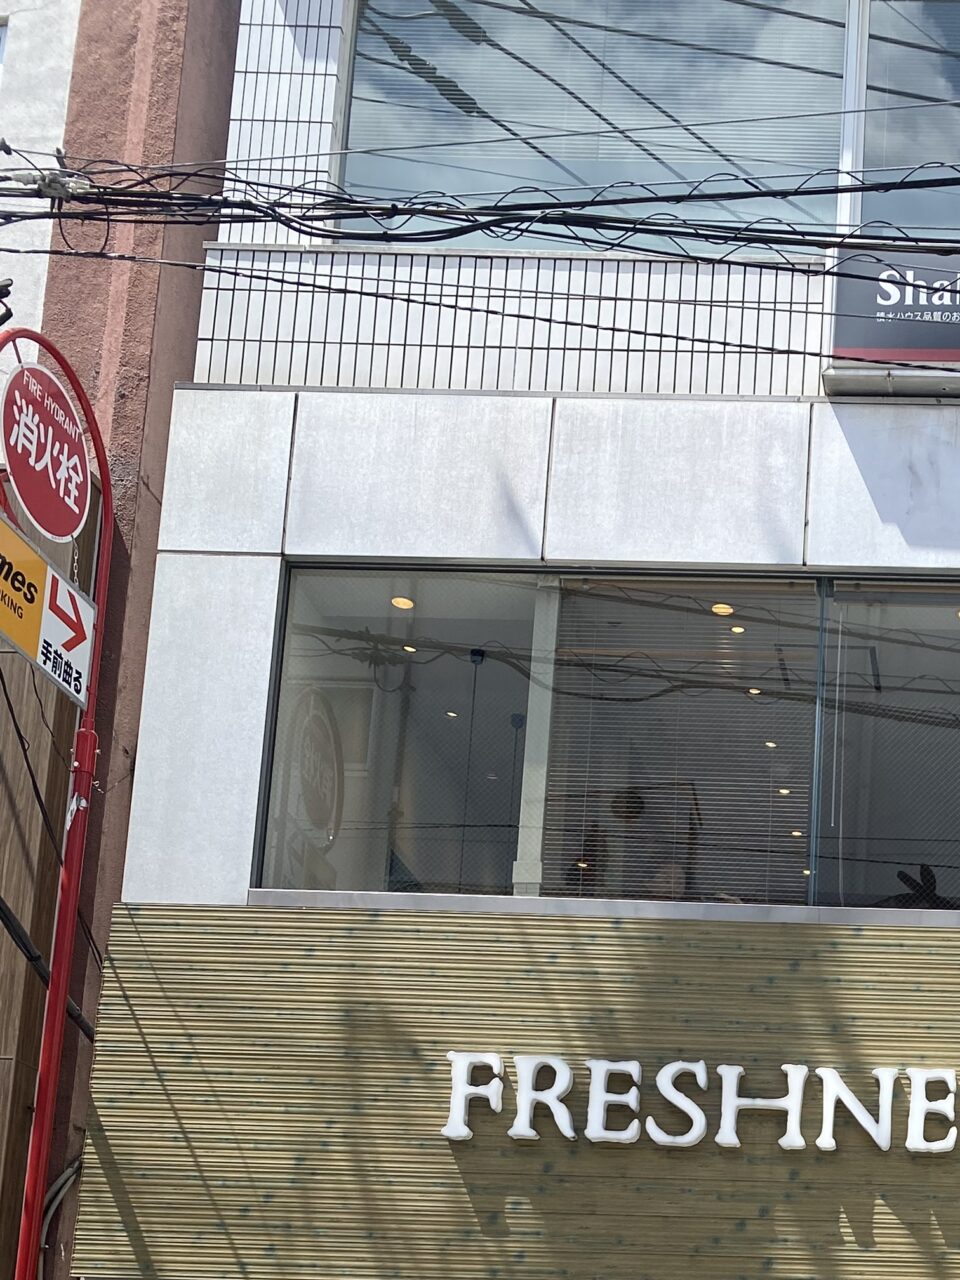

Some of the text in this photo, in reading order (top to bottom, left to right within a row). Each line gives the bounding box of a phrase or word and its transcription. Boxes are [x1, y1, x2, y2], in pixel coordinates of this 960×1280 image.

[875, 269, 952, 307] Sha
[22, 369, 81, 443] FIRE HYDRANT
[8, 389, 84, 515] 消火栓
[40, 638, 83, 696] 手前曲る
